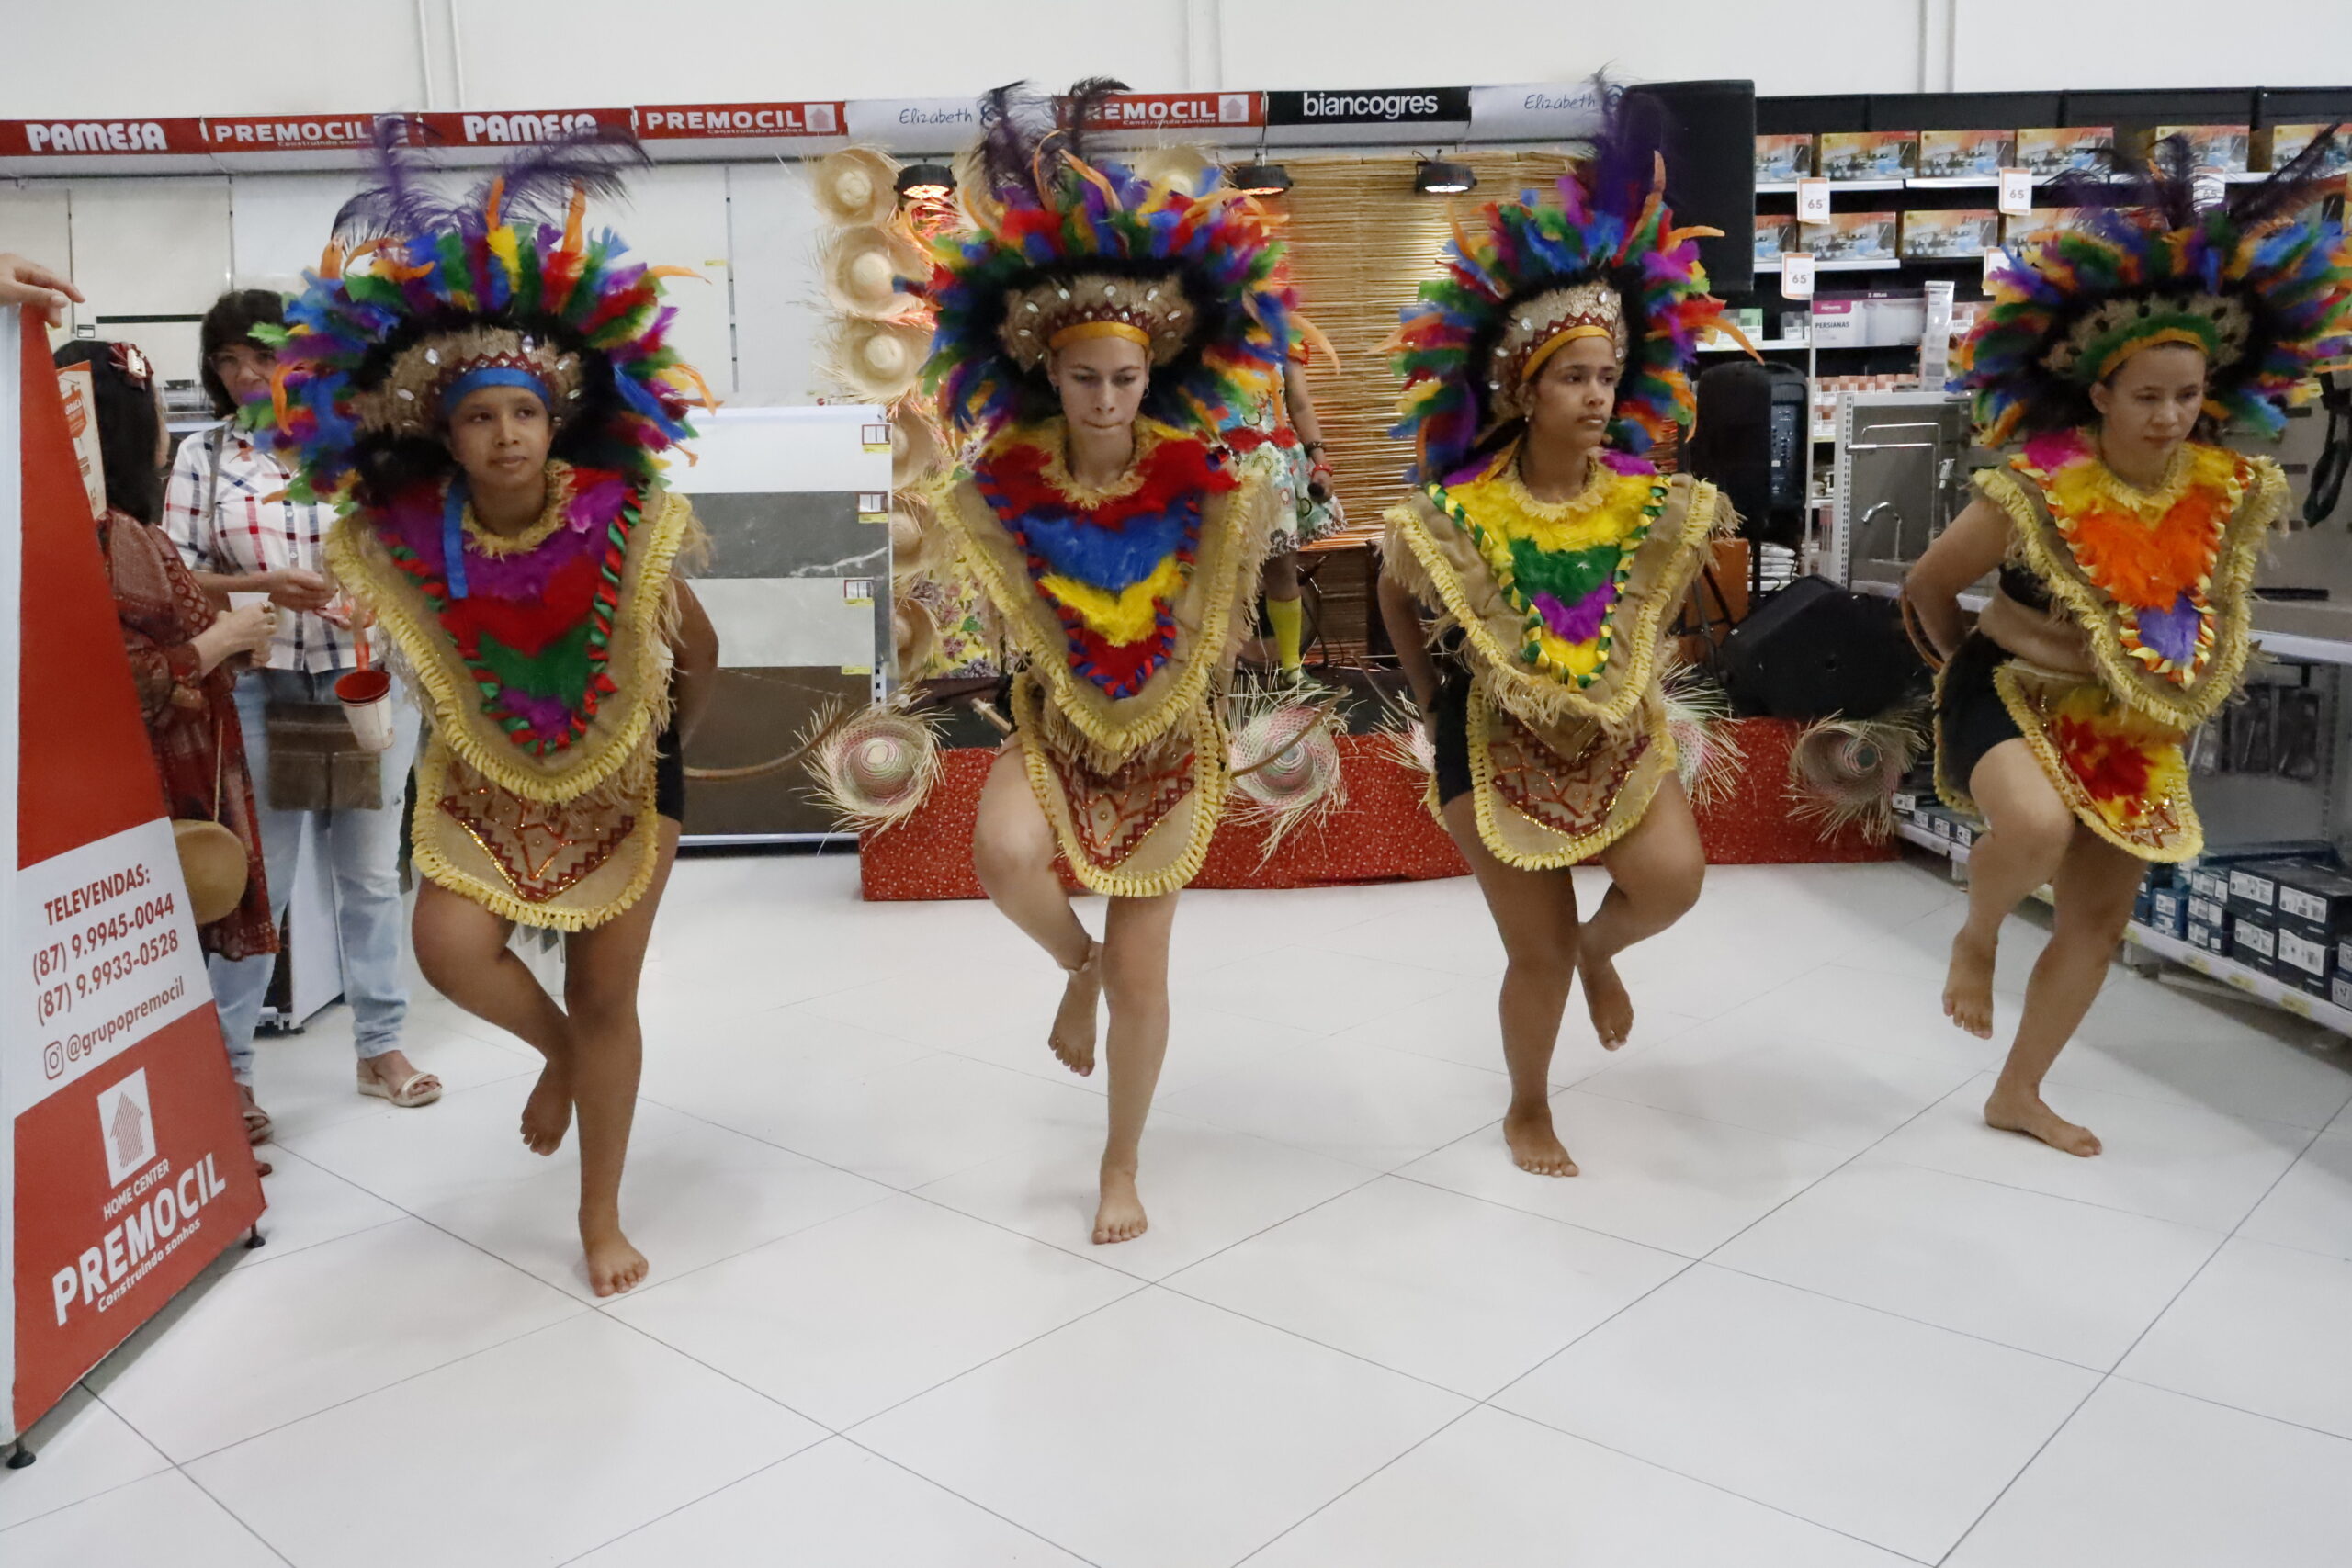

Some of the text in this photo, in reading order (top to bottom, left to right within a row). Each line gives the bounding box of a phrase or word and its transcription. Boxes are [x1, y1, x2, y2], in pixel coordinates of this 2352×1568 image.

[899, 107, 973, 125] Elizabeth
[1303, 92, 1439, 120] biancogres
[1524, 94, 1596, 110] Elizabeth
[214, 121, 371, 143] PREMOCIL
[646, 110, 802, 130] PREMOCIL
[25, 122, 168, 152] PAMESA
[1807, 199, 1823, 209] 65
[2009, 189, 2025, 199] 65
[1792, 275, 1807, 284] 65
[44, 863, 151, 926] TELEVENDAS:
[33, 892, 175, 986] (87) 9.9945-0044
[38, 929, 179, 1027] (87) 9.9933-0528
[66, 975, 185, 1063] @grupopremocil
[103, 1158, 170, 1222] HOME CENTER
[52, 1152, 227, 1327] PREMOCIL
[97, 1218, 201, 1313] Construindo sonhos
